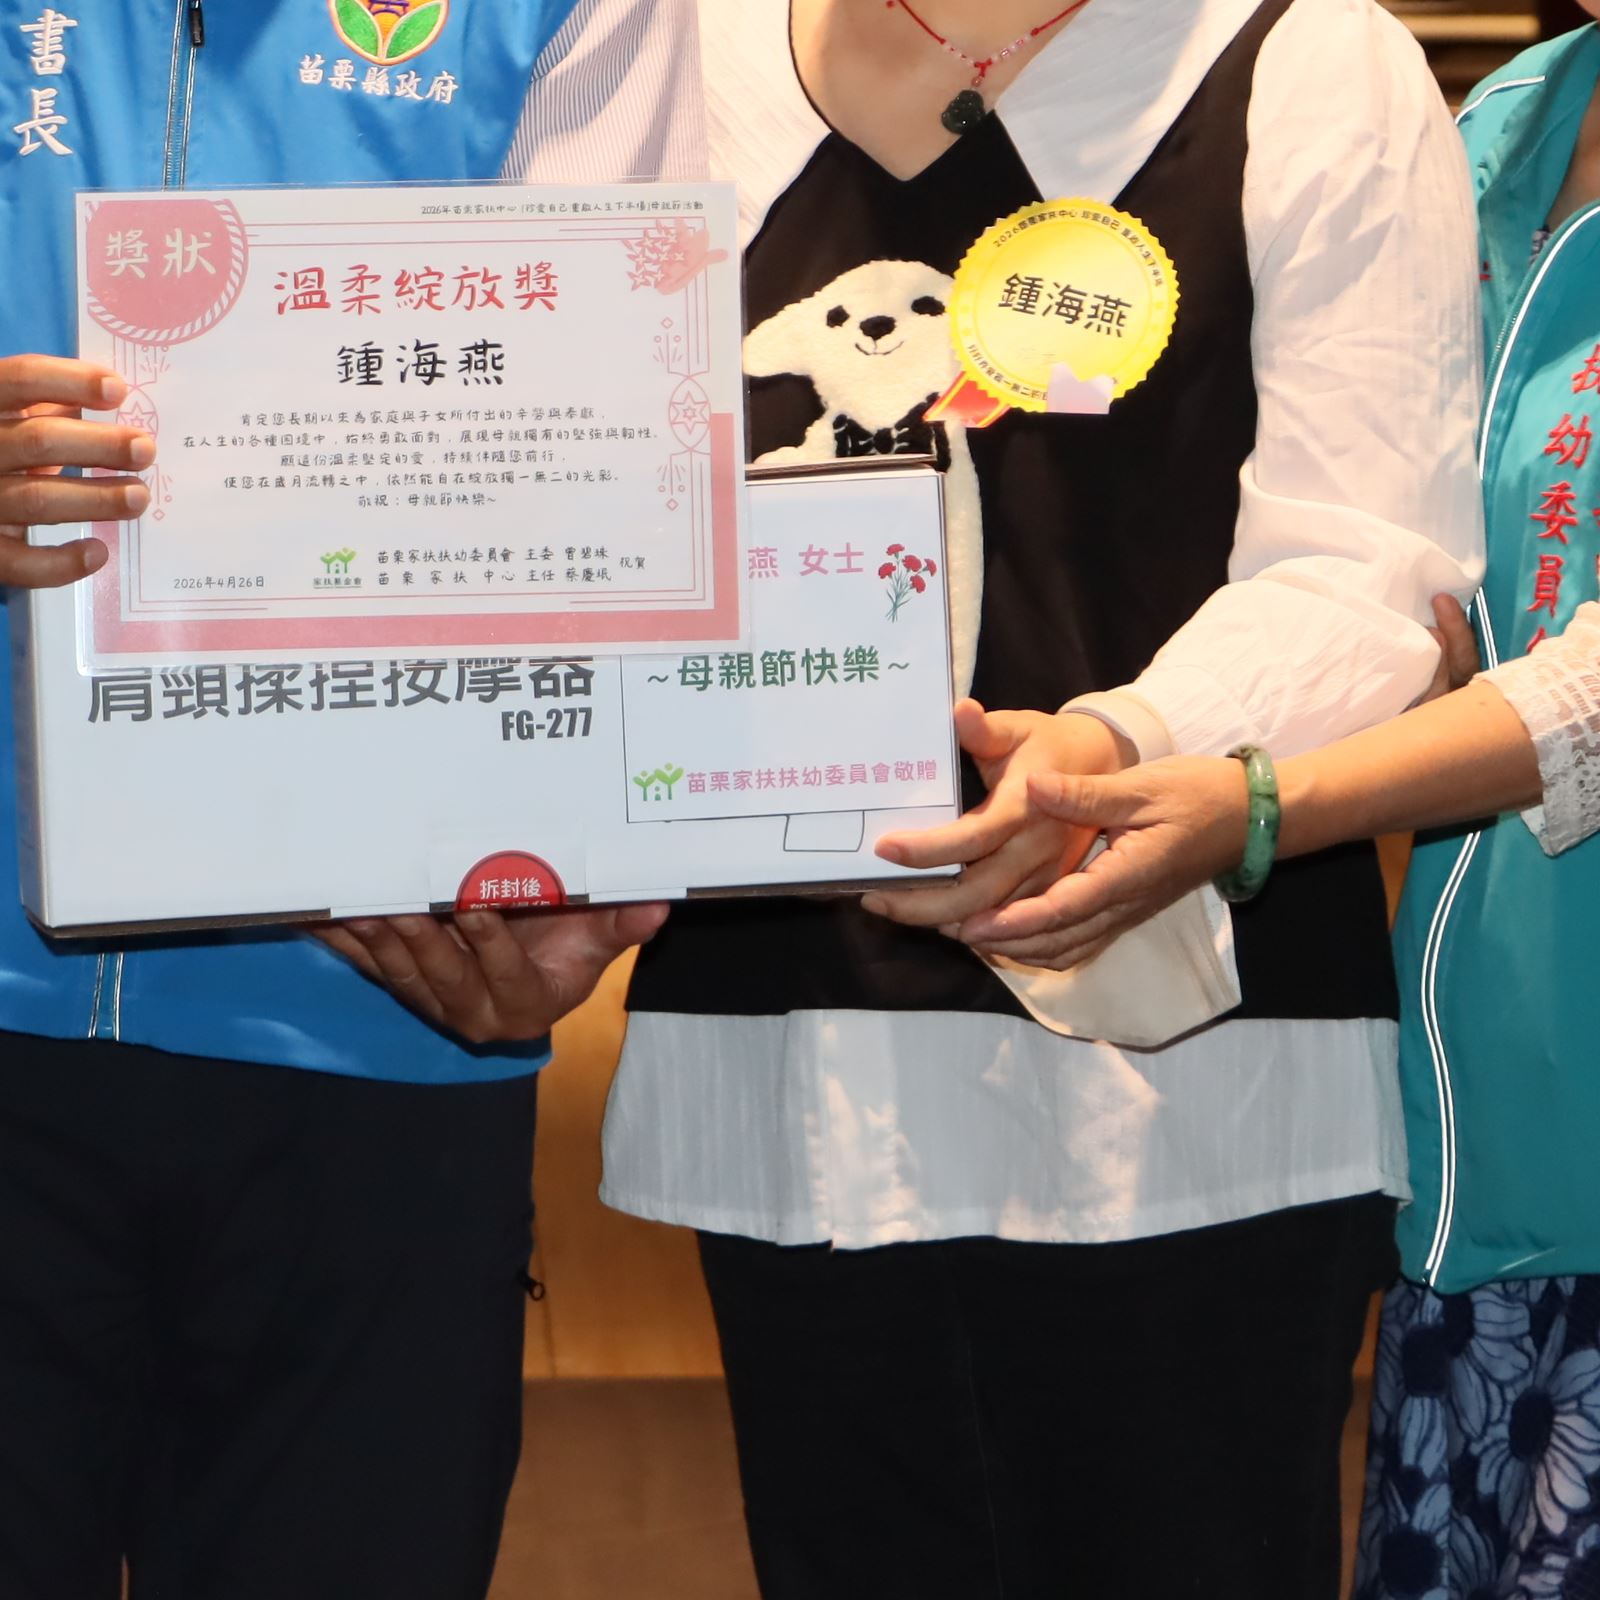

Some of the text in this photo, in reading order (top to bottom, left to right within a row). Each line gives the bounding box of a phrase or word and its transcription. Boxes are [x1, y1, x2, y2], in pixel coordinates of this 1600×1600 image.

[298, 52, 460, 105] 苗栗縣政府
[104, 226, 217, 281] 獎狀
[273, 261, 561, 317] 溫柔綻放獎
[998, 272, 1132, 338] 鍾海燕
[335, 338, 507, 387] 鍾海燕
[377, 548, 515, 565] 苗栗家扶扶幼委員會
[619, 556, 647, 570] 祝賀
[799, 542, 864, 577] 女士
[173, 575, 265, 590] 2026年4月26日
[525, 569, 556, 582] 主任
[501, 707, 593, 742] FG-277
[686, 759, 937, 794] 苗栗家扶扶幼委員會敬贈
[480, 877, 542, 900] 拆封後
